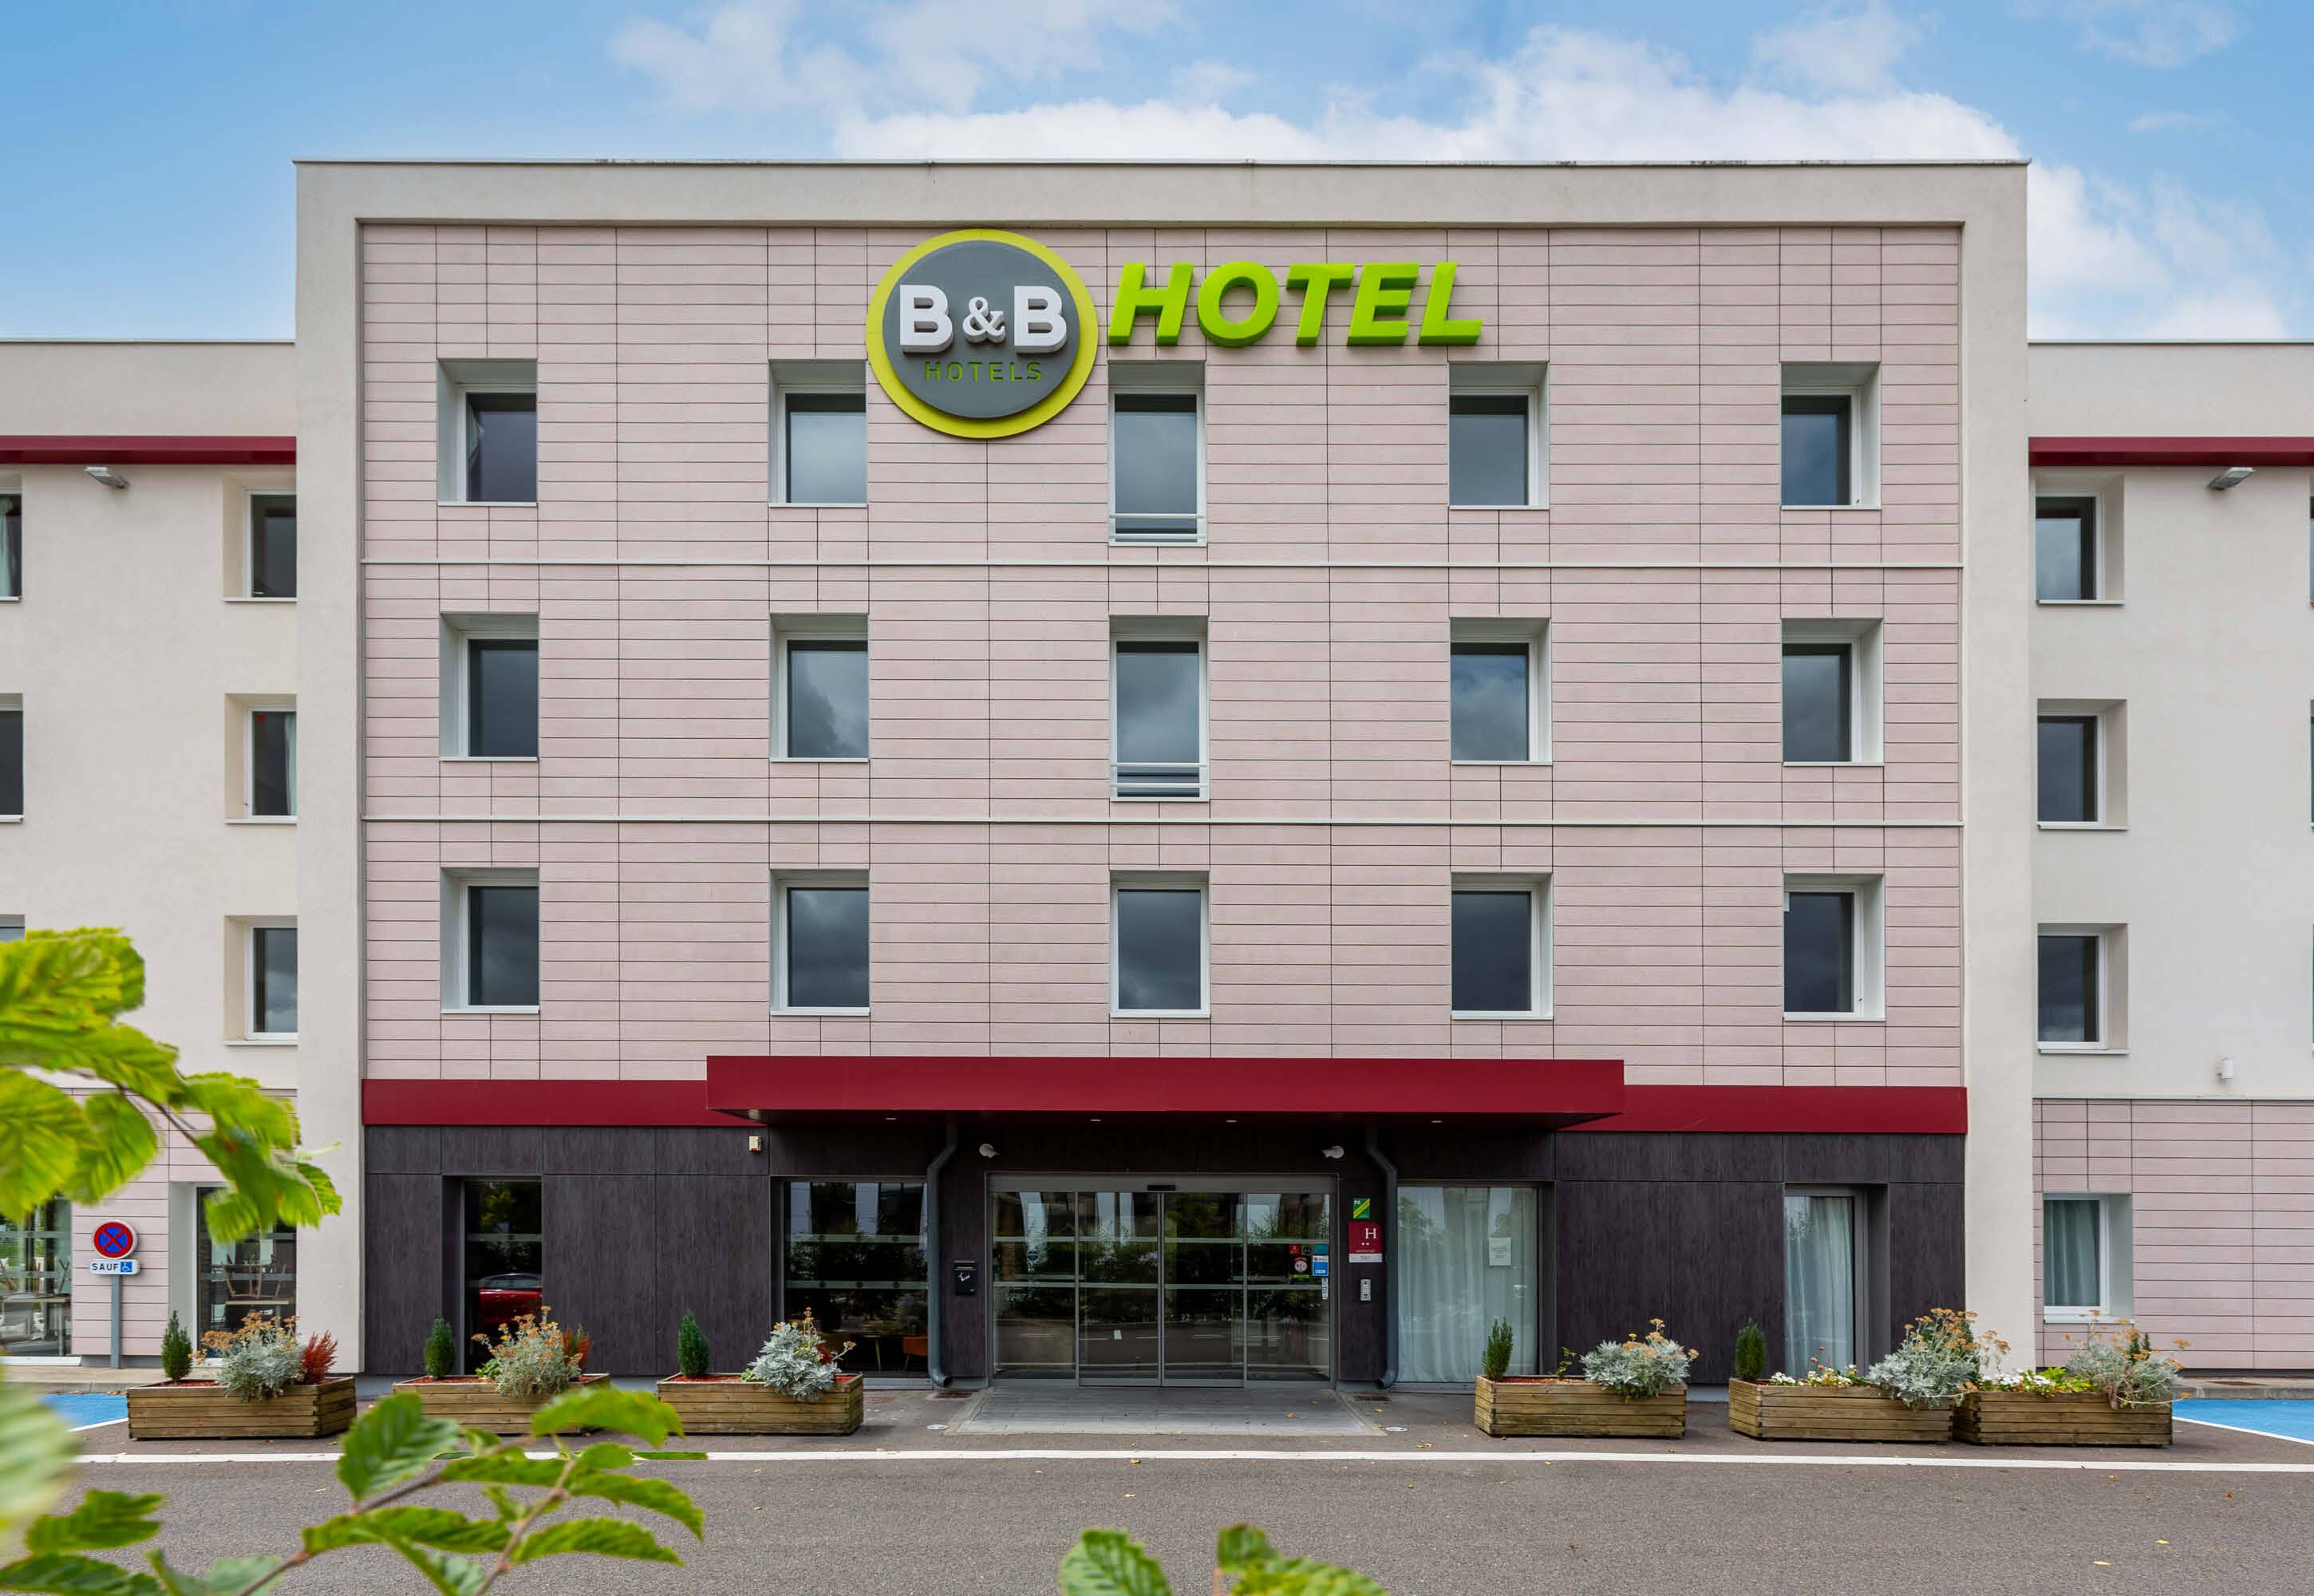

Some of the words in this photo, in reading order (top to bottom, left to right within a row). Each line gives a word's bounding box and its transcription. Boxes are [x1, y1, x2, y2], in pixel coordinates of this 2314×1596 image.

[900, 285, 1067, 354] B&B
[1108, 261, 1483, 347] HOTEL
[924, 361, 1042, 383] HOTELS
[1365, 1228, 1377, 1239] H
